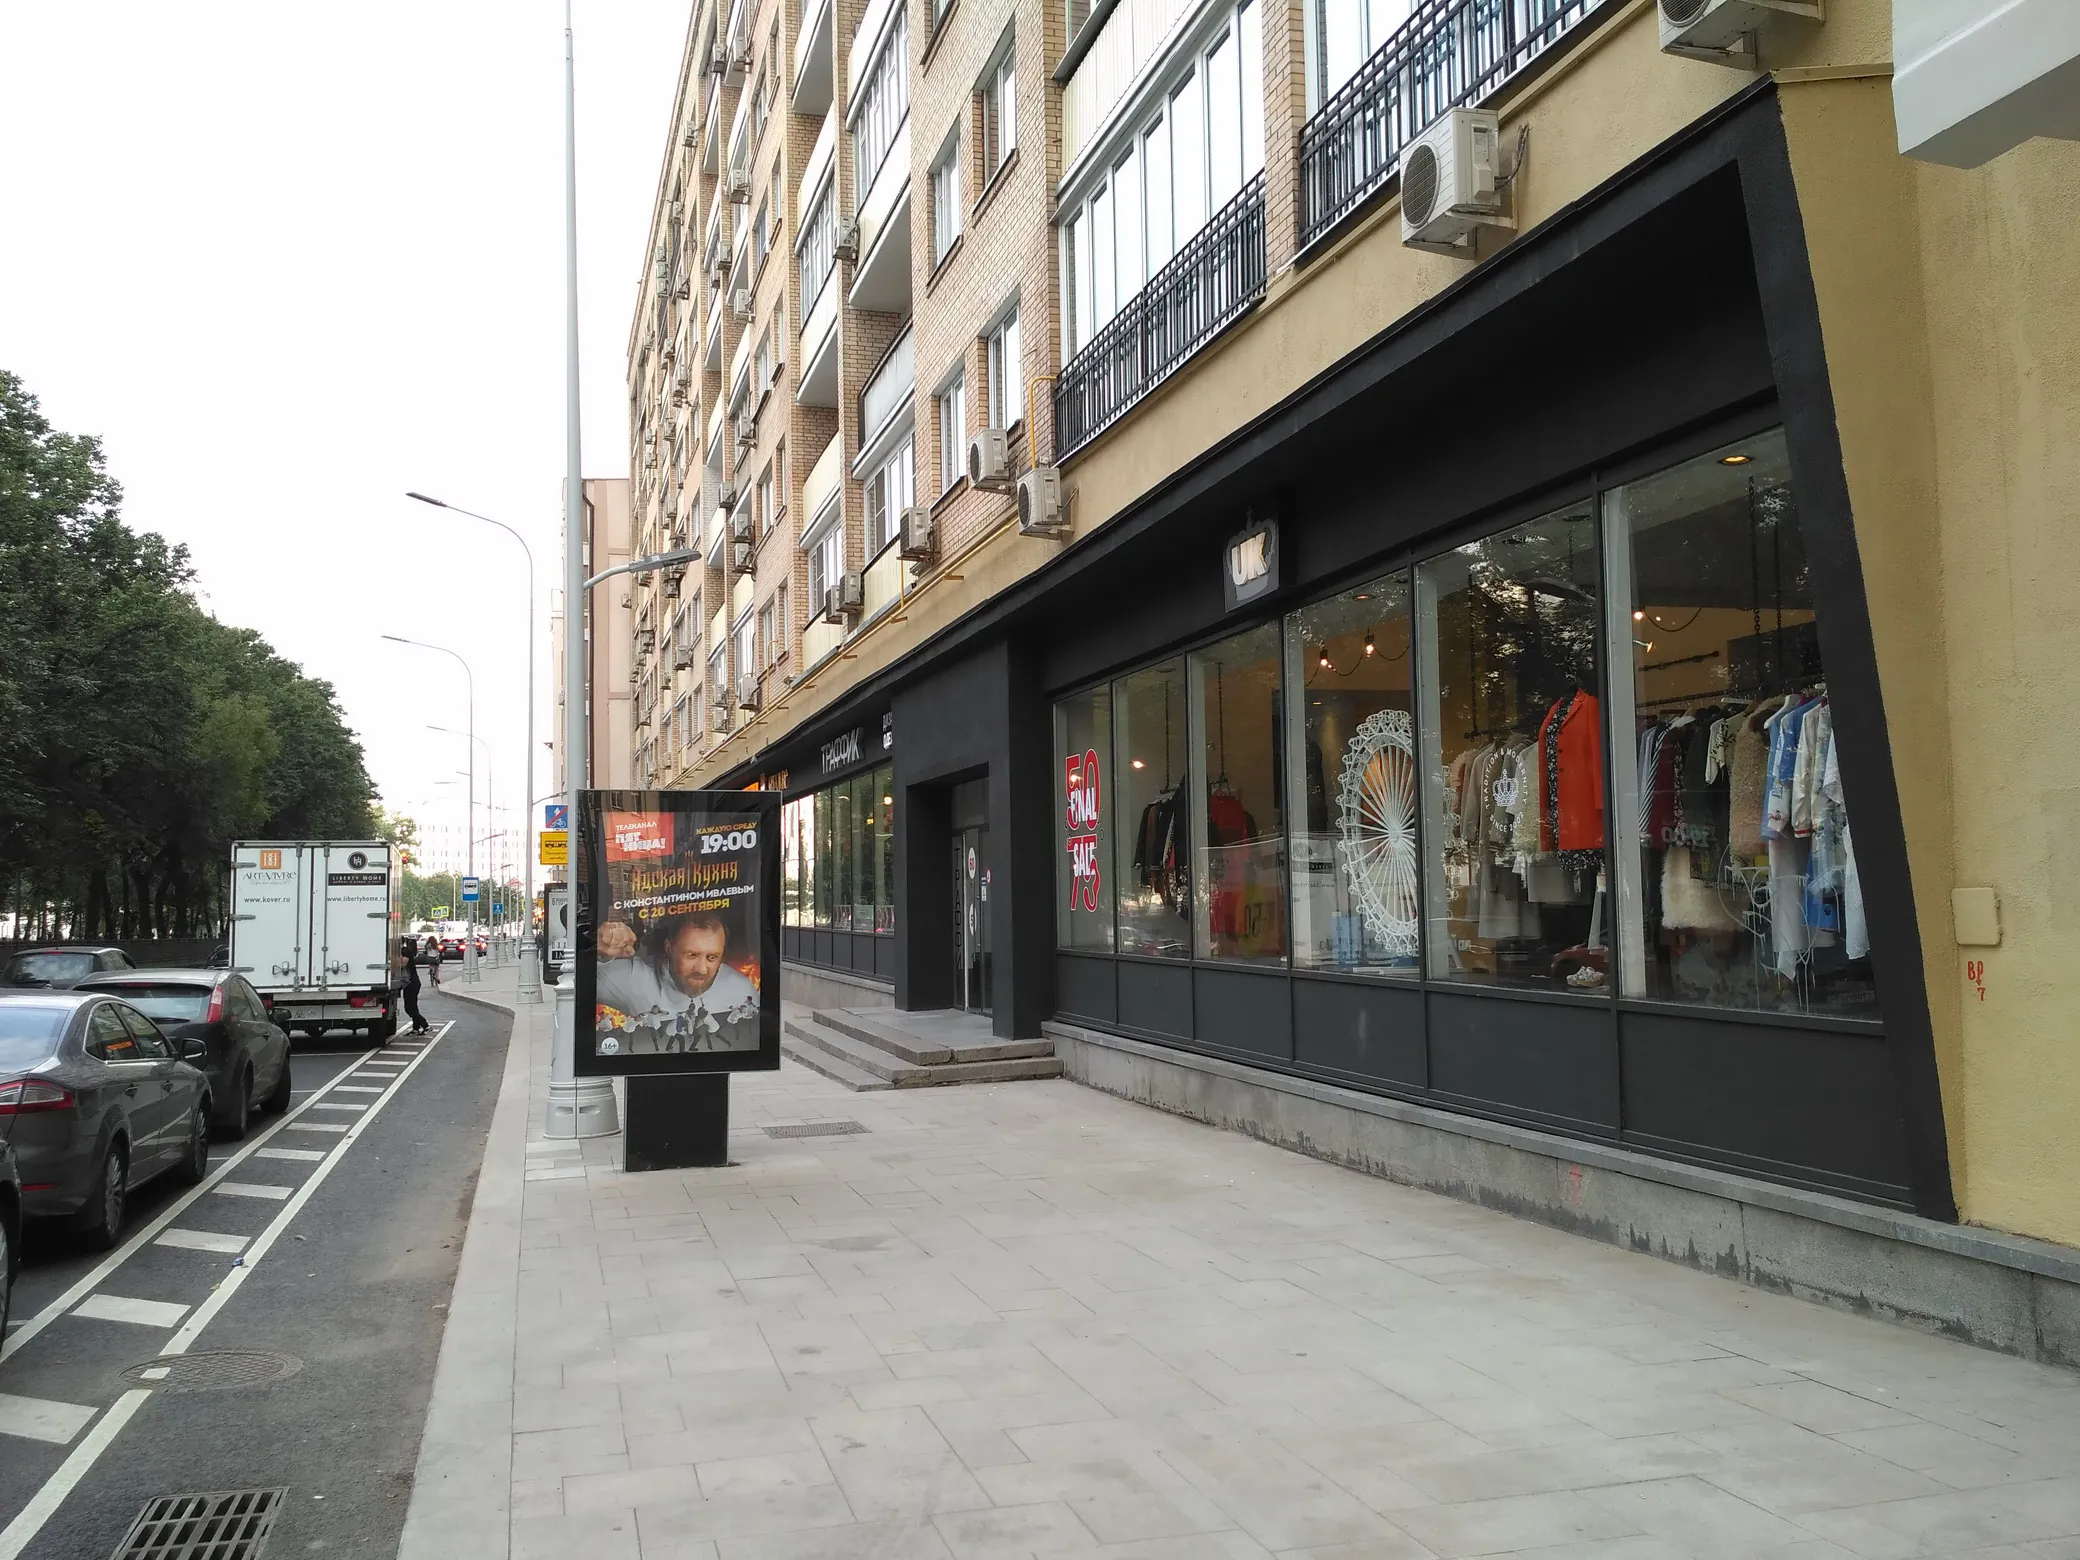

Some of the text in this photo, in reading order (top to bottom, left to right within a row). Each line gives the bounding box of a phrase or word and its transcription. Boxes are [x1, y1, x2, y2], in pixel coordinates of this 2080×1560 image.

[821, 727, 860, 775] ТРАФФИК
[1483, 751, 1499, 809] TRADITION
[1506, 748, 1528, 804] MODERNITY
[1071, 787, 1097, 823] FINAL
[616, 821, 657, 831] ТЕЛЕКАНАЛ
[696, 822, 757, 835] КАЖДУЮ СРЕДУ
[1490, 814, 1507, 832] SINCE
[615, 832, 641, 844] ПЯТ
[700, 830, 757, 854] 19:00
[1073, 842, 1096, 877] SALE
[327, 895, 386, 903] www.libertyhome.ru
[614, 884, 754, 909] С КОНСТАНТИНОМ ИВЛЕВЫМ
[638, 898, 730, 919] С 20 СЕНТЯБРЯ
